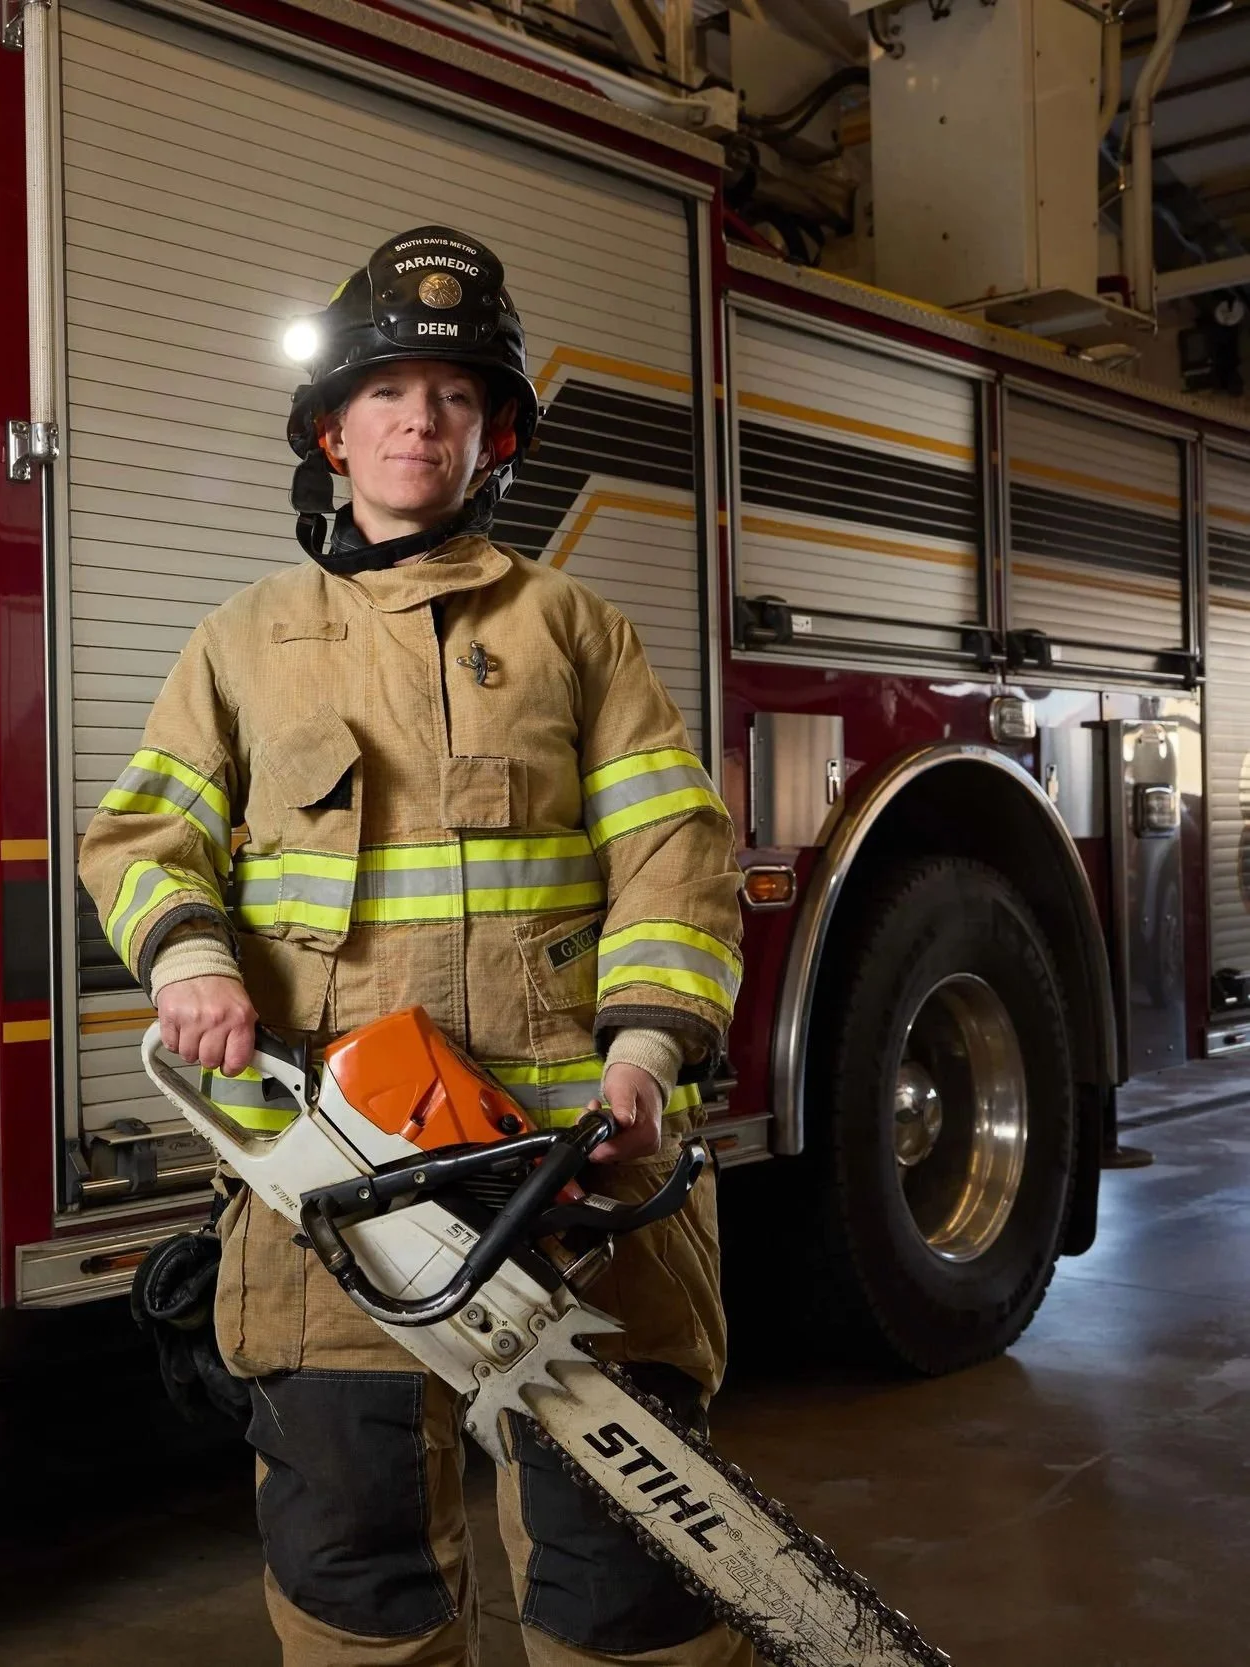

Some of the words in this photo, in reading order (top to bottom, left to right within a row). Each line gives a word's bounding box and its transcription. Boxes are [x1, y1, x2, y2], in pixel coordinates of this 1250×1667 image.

[394, 239, 422, 252] SOUTH
[424, 238, 448, 246] DAVIS
[449, 241, 477, 256] METRO
[394, 256, 479, 277] PARAMEDIC
[418, 323, 458, 336] DEEM
[561, 927, 598, 958] G-XCEL
[269, 1182, 299, 1211] STIHL
[582, 1421, 727, 1554] STIHL
[737, 1550, 755, 1569] Made
[763, 1573, 792, 1601] Germany
